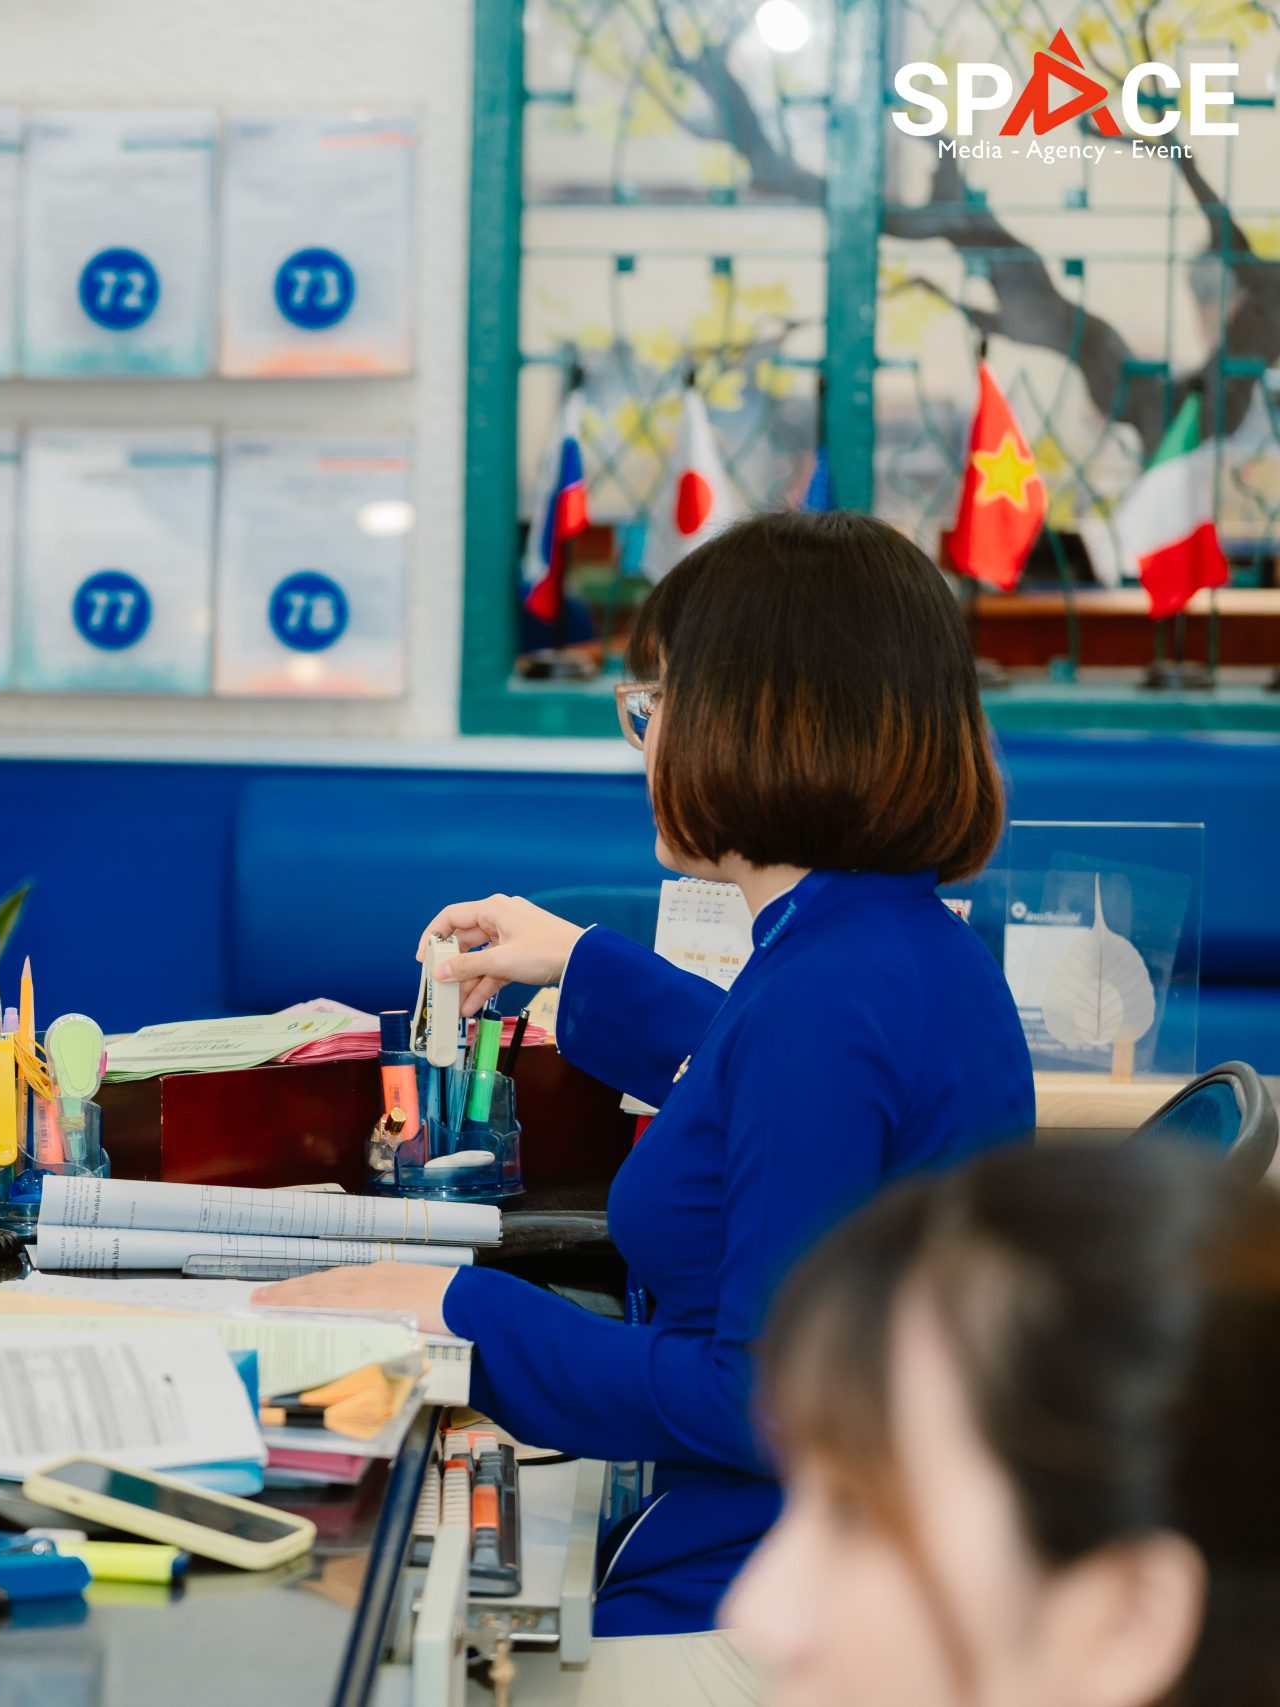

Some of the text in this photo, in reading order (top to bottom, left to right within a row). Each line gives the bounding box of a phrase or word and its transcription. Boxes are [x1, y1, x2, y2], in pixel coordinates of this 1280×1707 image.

[96, 270, 147, 310] 72
[290, 268, 341, 307] 73
[88, 590, 136, 630] 77
[285, 593, 336, 632] 78
[111, 1237, 120, 1260] khách
